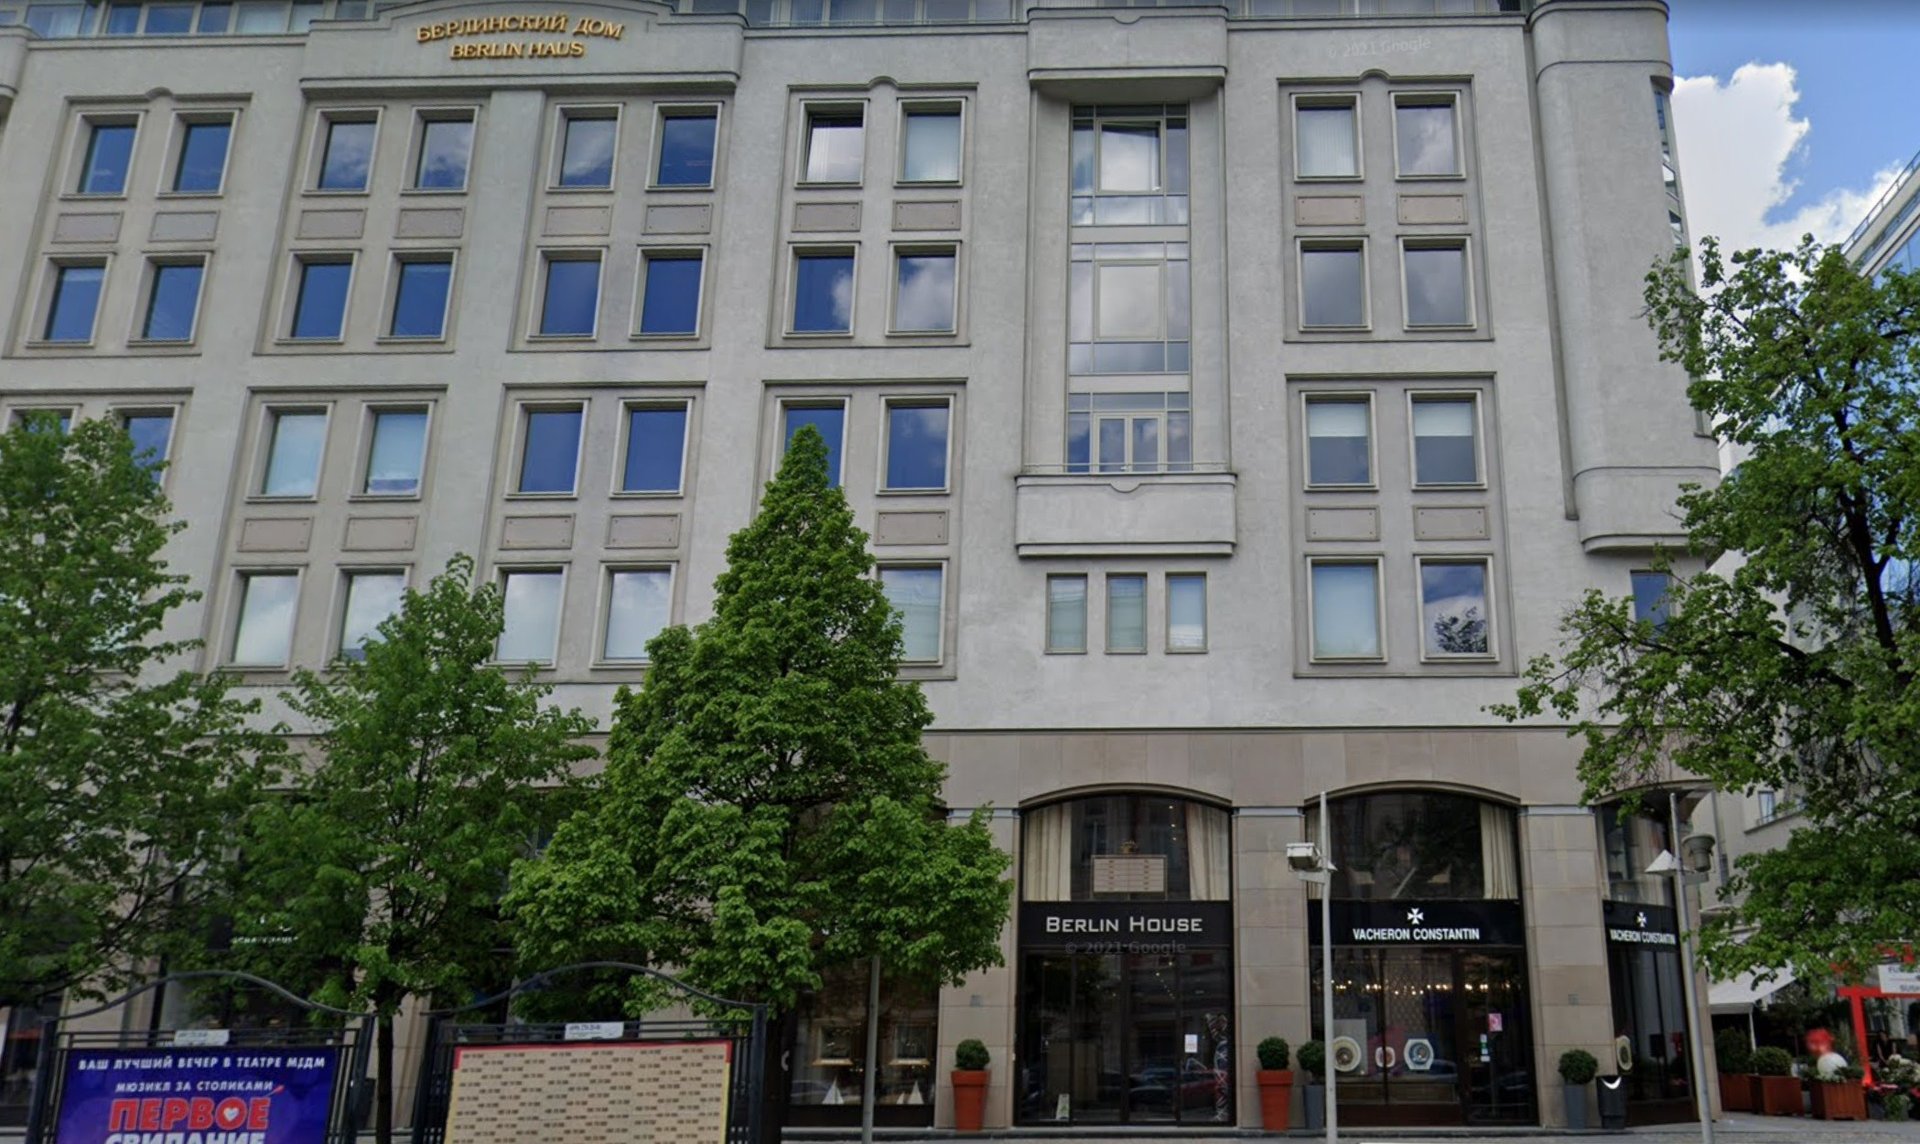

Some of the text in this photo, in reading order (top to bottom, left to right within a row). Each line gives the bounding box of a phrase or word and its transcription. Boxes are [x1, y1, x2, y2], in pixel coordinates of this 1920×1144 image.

[417, 14, 625, 42] БЕРЛИНСКИЙ ДОМ
[450, 41, 585, 60] BERLIN HAUS
[1353, 928, 1480, 940] VACHERON CONSTANTIN
[78, 1059, 109, 1070] ВАШ
[113, 1055, 173, 1070] ЛУЧШИЙ
[177, 1057, 218, 1069] ВЕЧЕР
[223, 1057, 231, 1068] В
[237, 1056, 282, 1068] ТЕАТРЕ
[115, 1080, 274, 1093] МЮЗИКЛ ЗА СТОЛИКАМИ
[109, 1097, 271, 1131] ПЕРВОЕ
